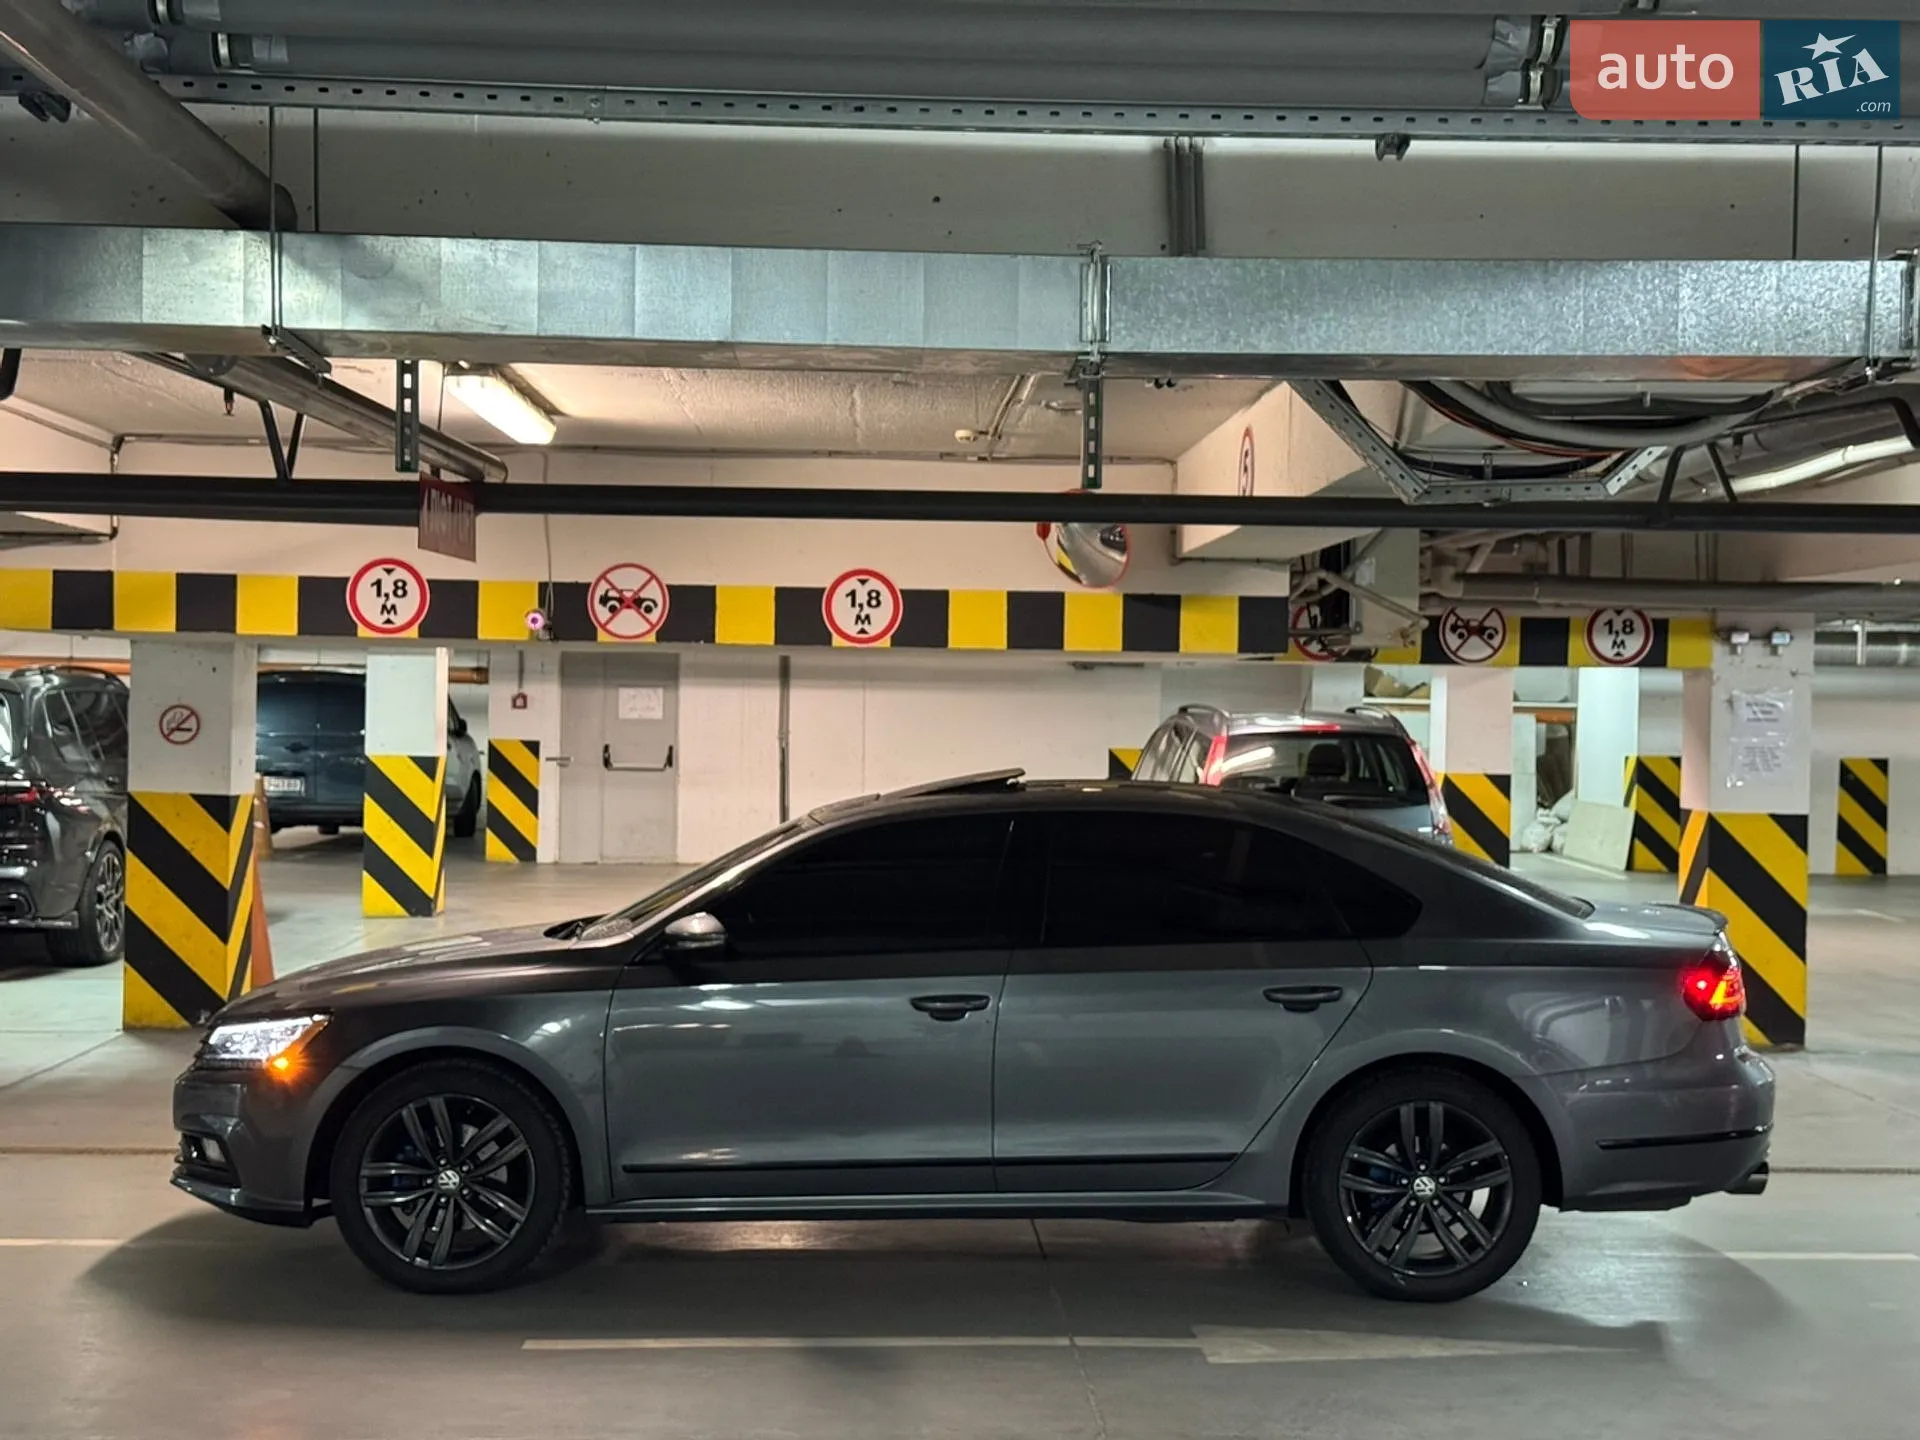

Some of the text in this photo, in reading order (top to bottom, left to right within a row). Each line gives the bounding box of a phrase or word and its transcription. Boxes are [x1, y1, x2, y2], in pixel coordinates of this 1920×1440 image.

[370, 578, 408, 603] 1,8
[845, 588, 882, 613] 1,8
[1603, 618, 1635, 638] 1,8
